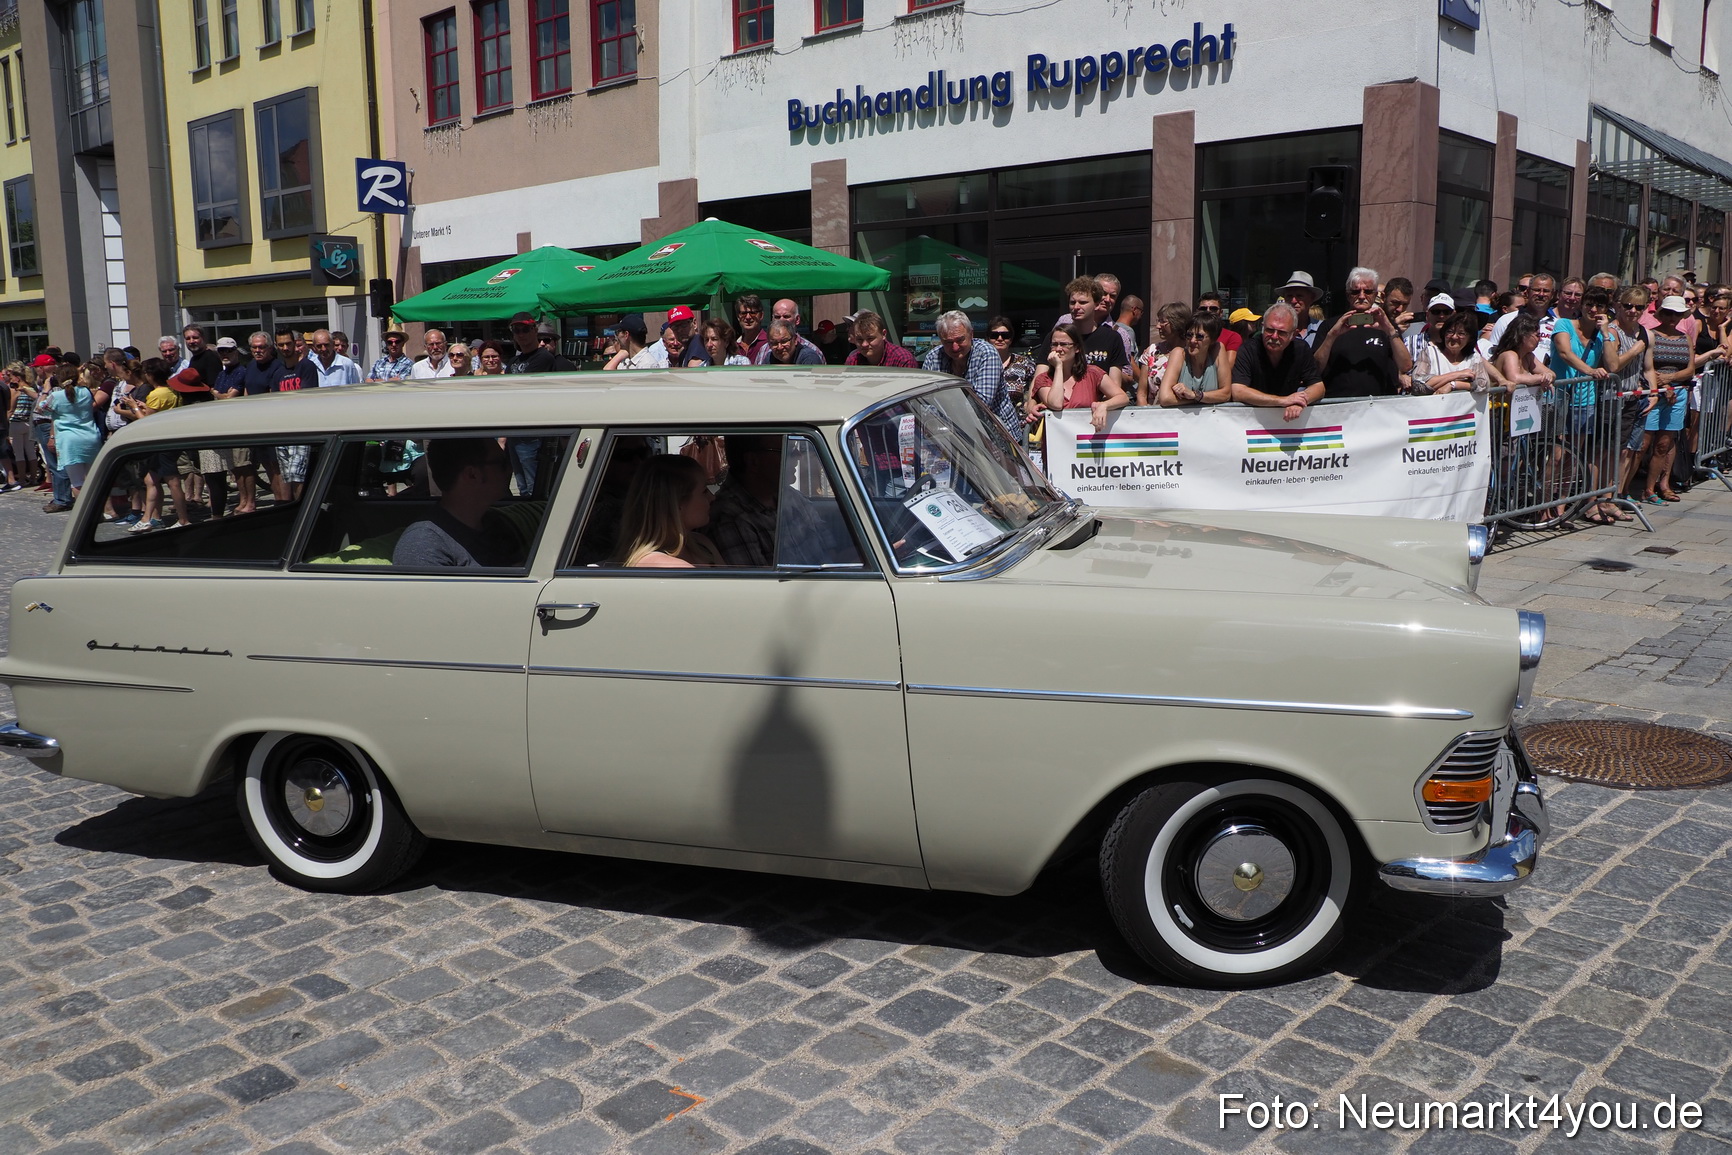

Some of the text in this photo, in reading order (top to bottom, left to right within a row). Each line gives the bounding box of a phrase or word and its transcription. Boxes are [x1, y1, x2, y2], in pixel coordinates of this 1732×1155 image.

[788, 21, 1236, 131] Buchhandlung Rupprecht
[431, 227, 445, 237] Markt
[445, 224, 452, 235] 15
[330, 248, 348, 269] G2
[910, 275, 939, 286] OLDTIMER
[1401, 440, 1477, 463] NeuerMarkt
[1070, 460, 1184, 479] NeuerMarkt
[1241, 453, 1350, 473] NeuerMarkt
[1407, 466, 1440, 475] einkaufen
[1441, 464, 1455, 473] leben
[1076, 482, 1180, 493] einkaufen leben genießen
[1245, 473, 1343, 486] einkaufen leben genießen
